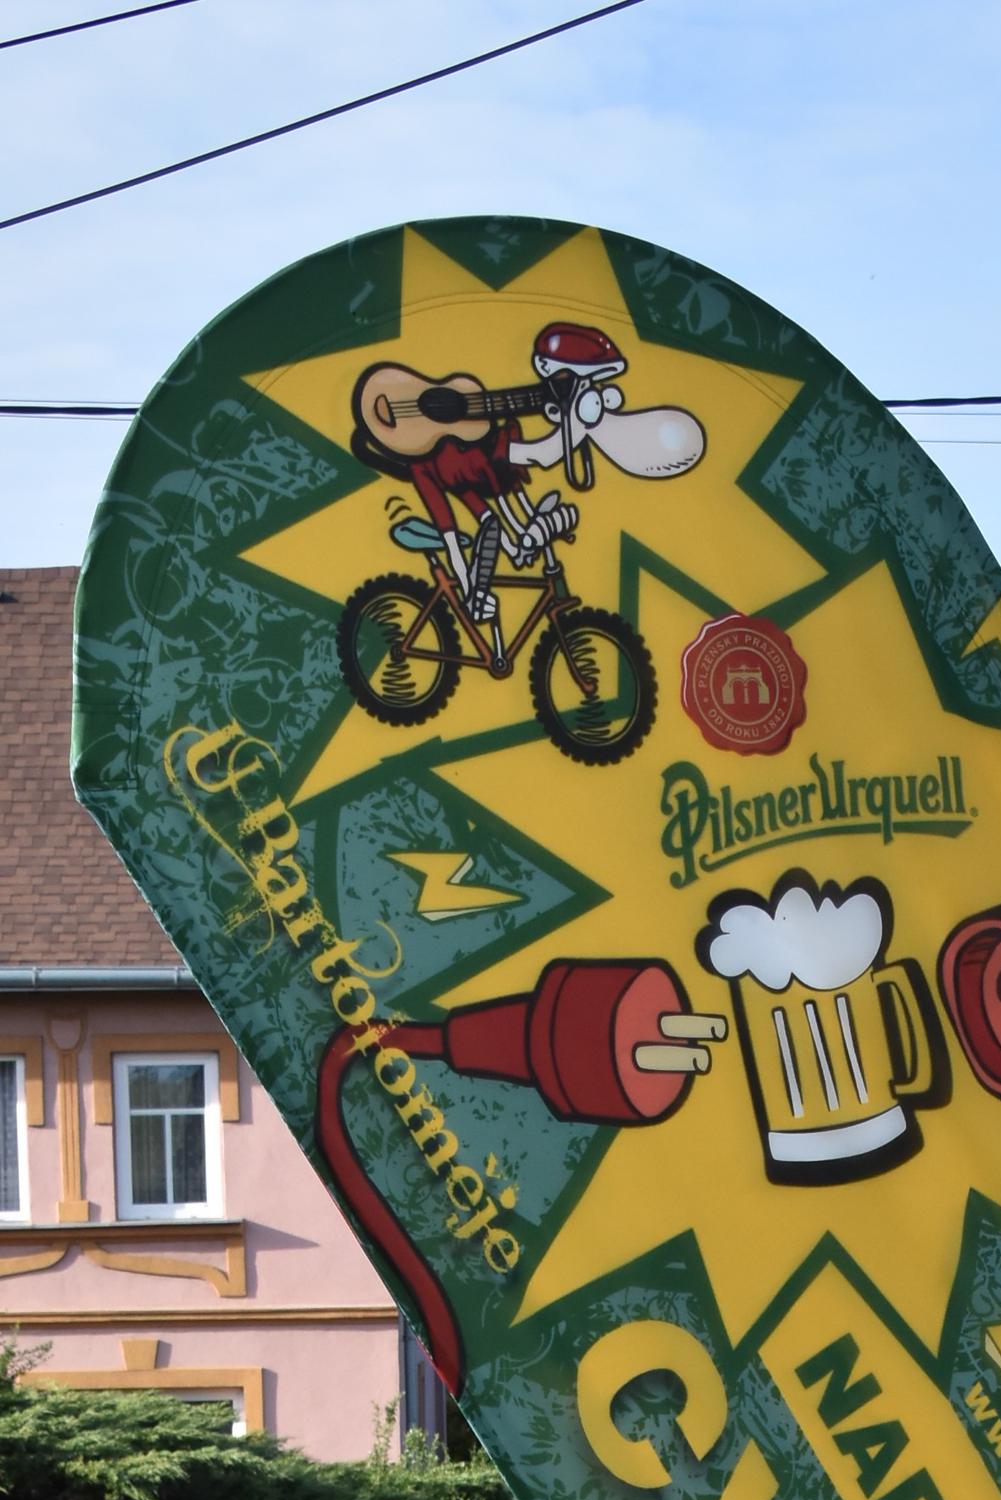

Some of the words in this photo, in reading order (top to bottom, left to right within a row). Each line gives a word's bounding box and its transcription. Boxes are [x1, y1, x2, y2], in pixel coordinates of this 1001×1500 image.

[744, 634, 791, 689] PRAZDROJ
[708, 708, 724, 726] OD
[726, 724, 760, 738] ROKU
[763, 707, 786, 734] 1842
[660, 760, 818, 889] Pilsner
[809, 752, 967, 846] Urquell
